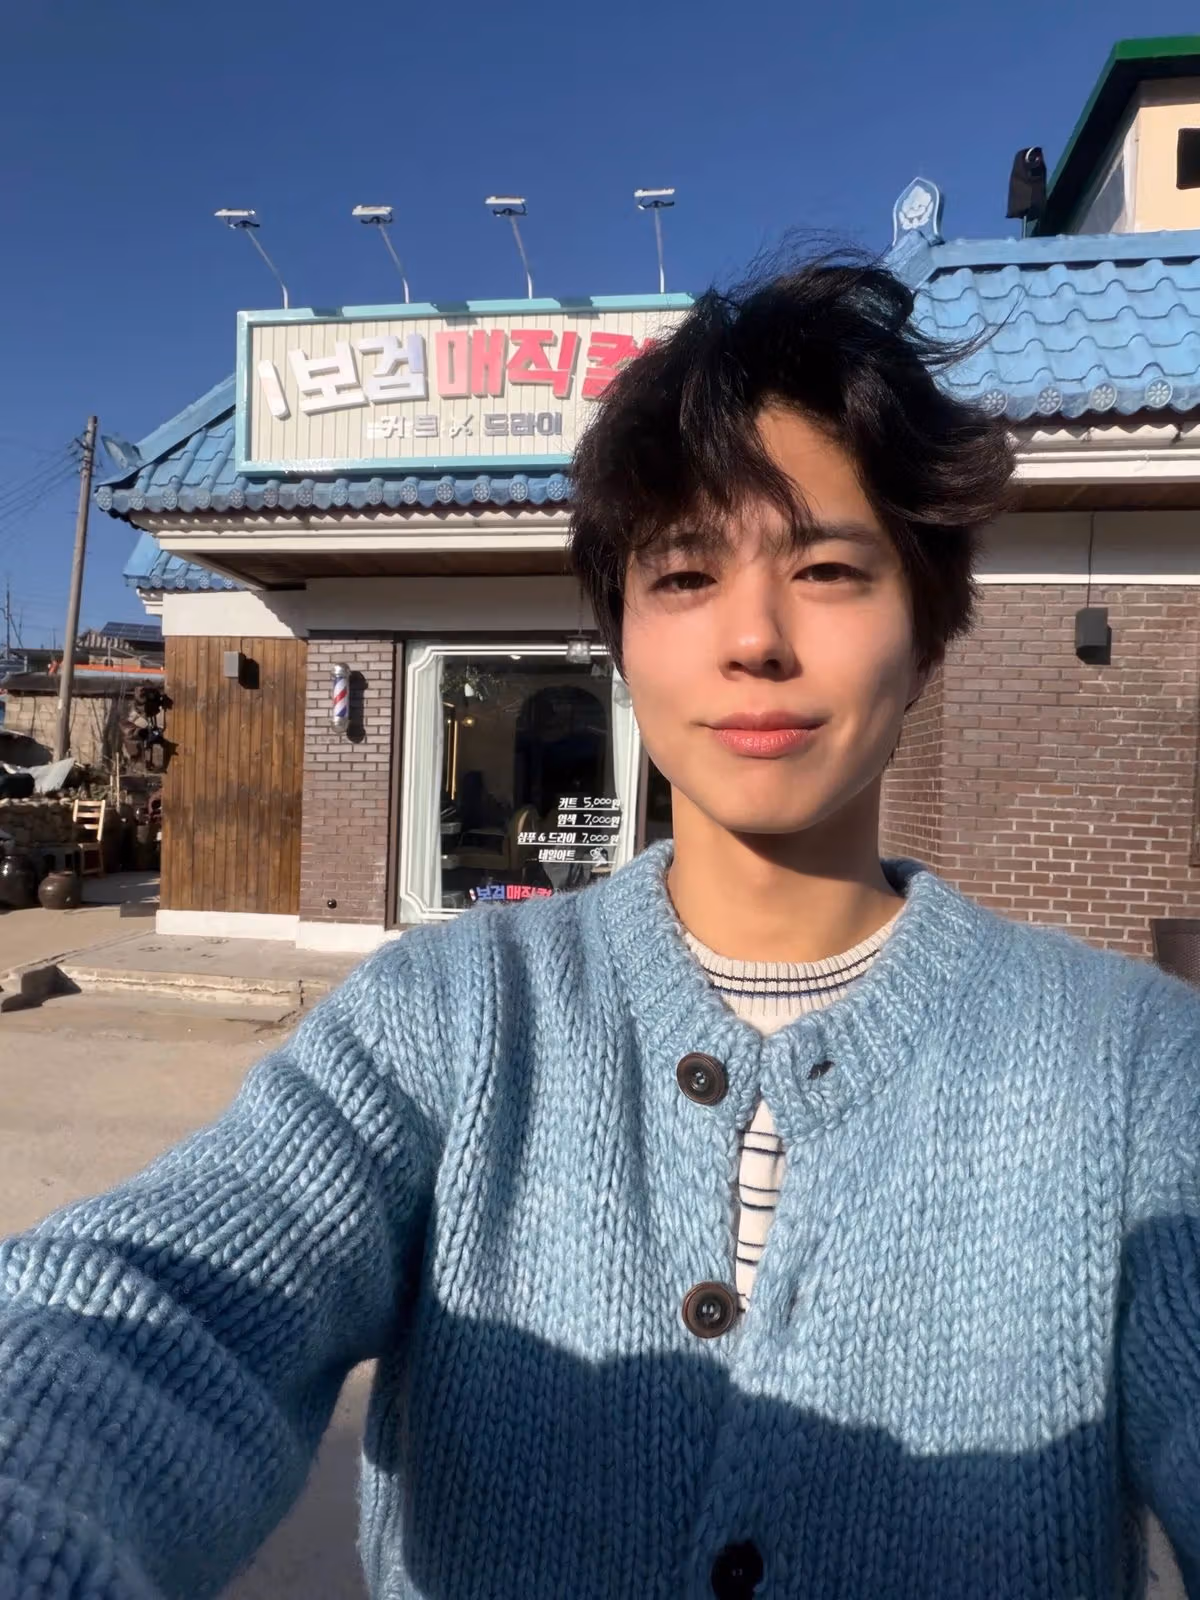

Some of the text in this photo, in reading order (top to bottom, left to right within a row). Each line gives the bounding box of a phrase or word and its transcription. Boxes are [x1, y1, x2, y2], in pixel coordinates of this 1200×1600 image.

[288, 333, 428, 416] 보검
[484, 412, 562, 437] 드라이
[558, 797, 578, 808] 커트
[557, 814, 577, 825] 염색
[538, 832, 546, 842] &
[547, 832, 576, 844] 드라이
[538, 849, 576, 861] 네일아트
